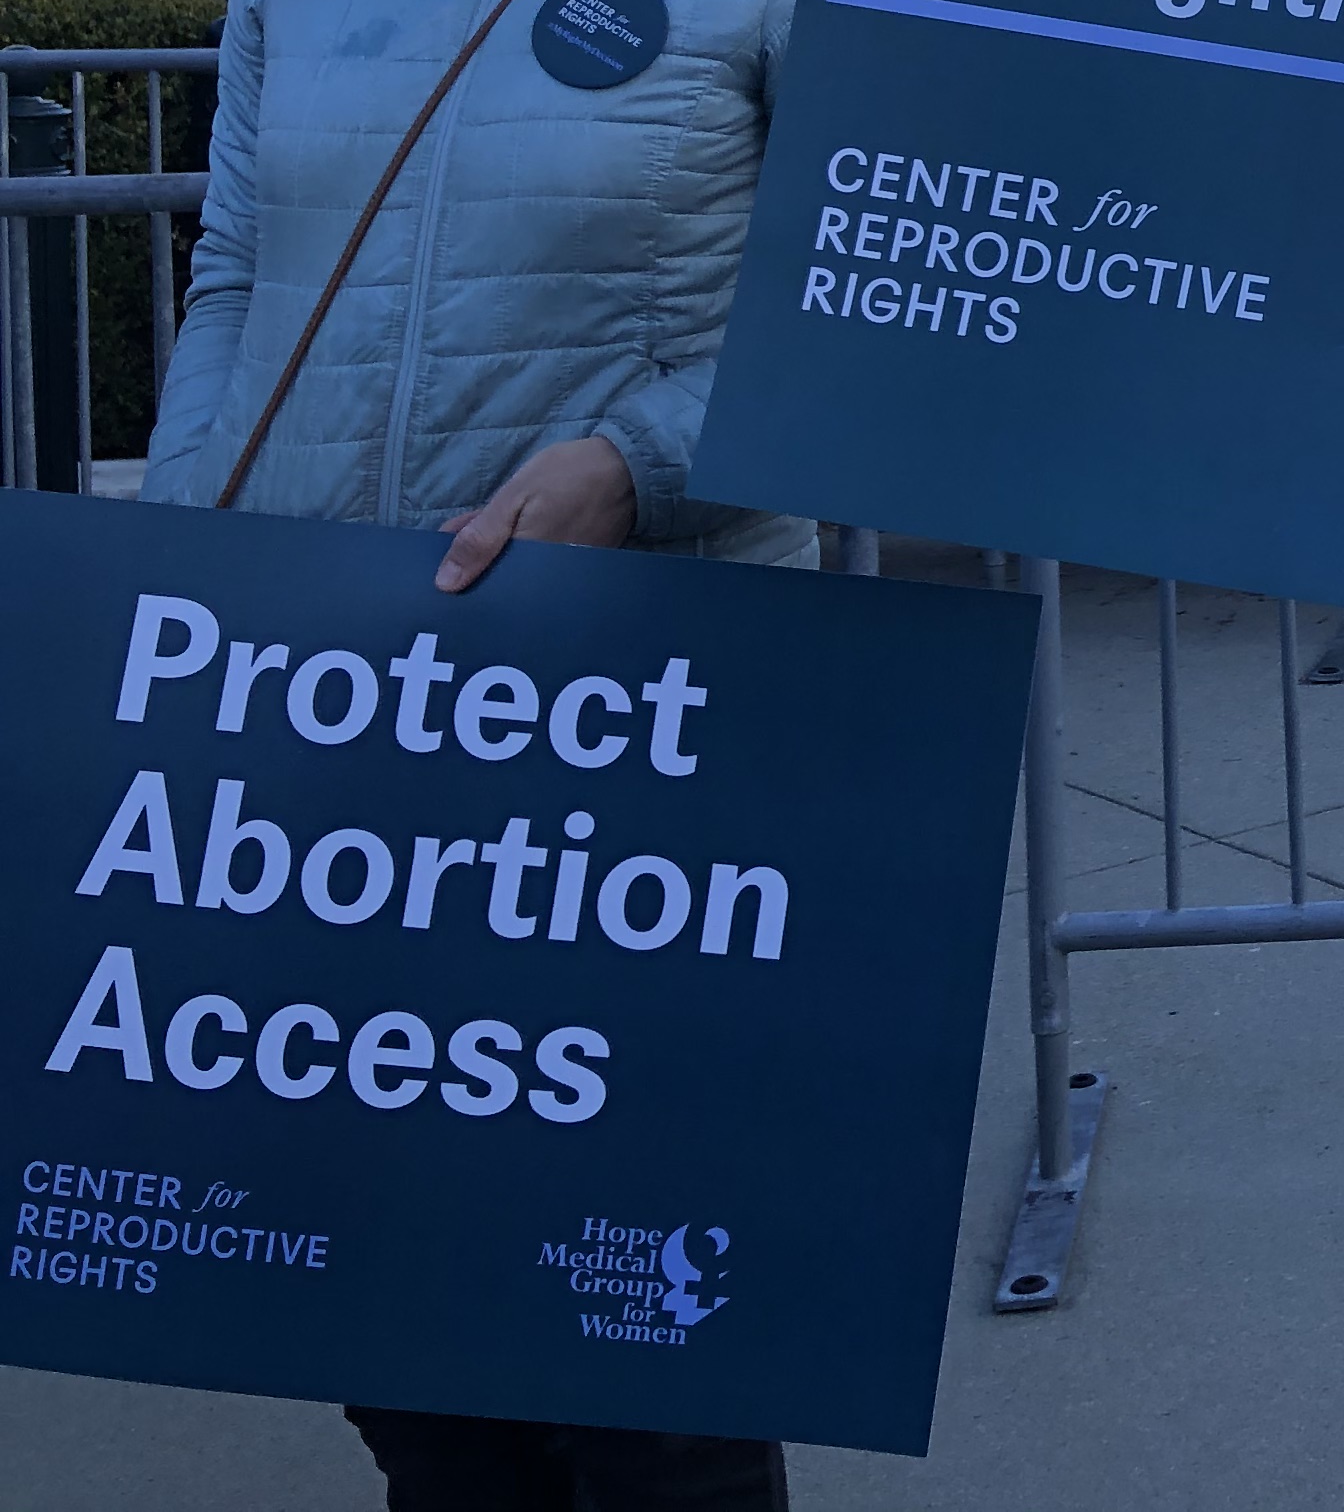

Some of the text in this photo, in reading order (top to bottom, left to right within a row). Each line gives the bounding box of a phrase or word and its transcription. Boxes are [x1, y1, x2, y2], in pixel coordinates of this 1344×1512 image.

[558, 6, 598, 34] RIGHTS
[827, 147, 1159, 232] CENTER for
[814, 205, 1271, 322] REPRODUCTIVE
[801, 266, 1020, 344] RIGHTS
[115, 593, 708, 777] Protect
[75, 770, 790, 960] Abortion
[44, 946, 611, 1123] Access
[23, 1160, 250, 1213] CENTER for
[16, 1202, 330, 1268] REPRODUCTIVE
[536, 1241, 657, 1274] Medical
[581, 1217, 664, 1255] Hope
[10, 1245, 158, 1294] RIGHTS
[570, 1268, 665, 1308] Group
[579, 1313, 687, 1345] Women
[622, 1302, 656, 1322] for
